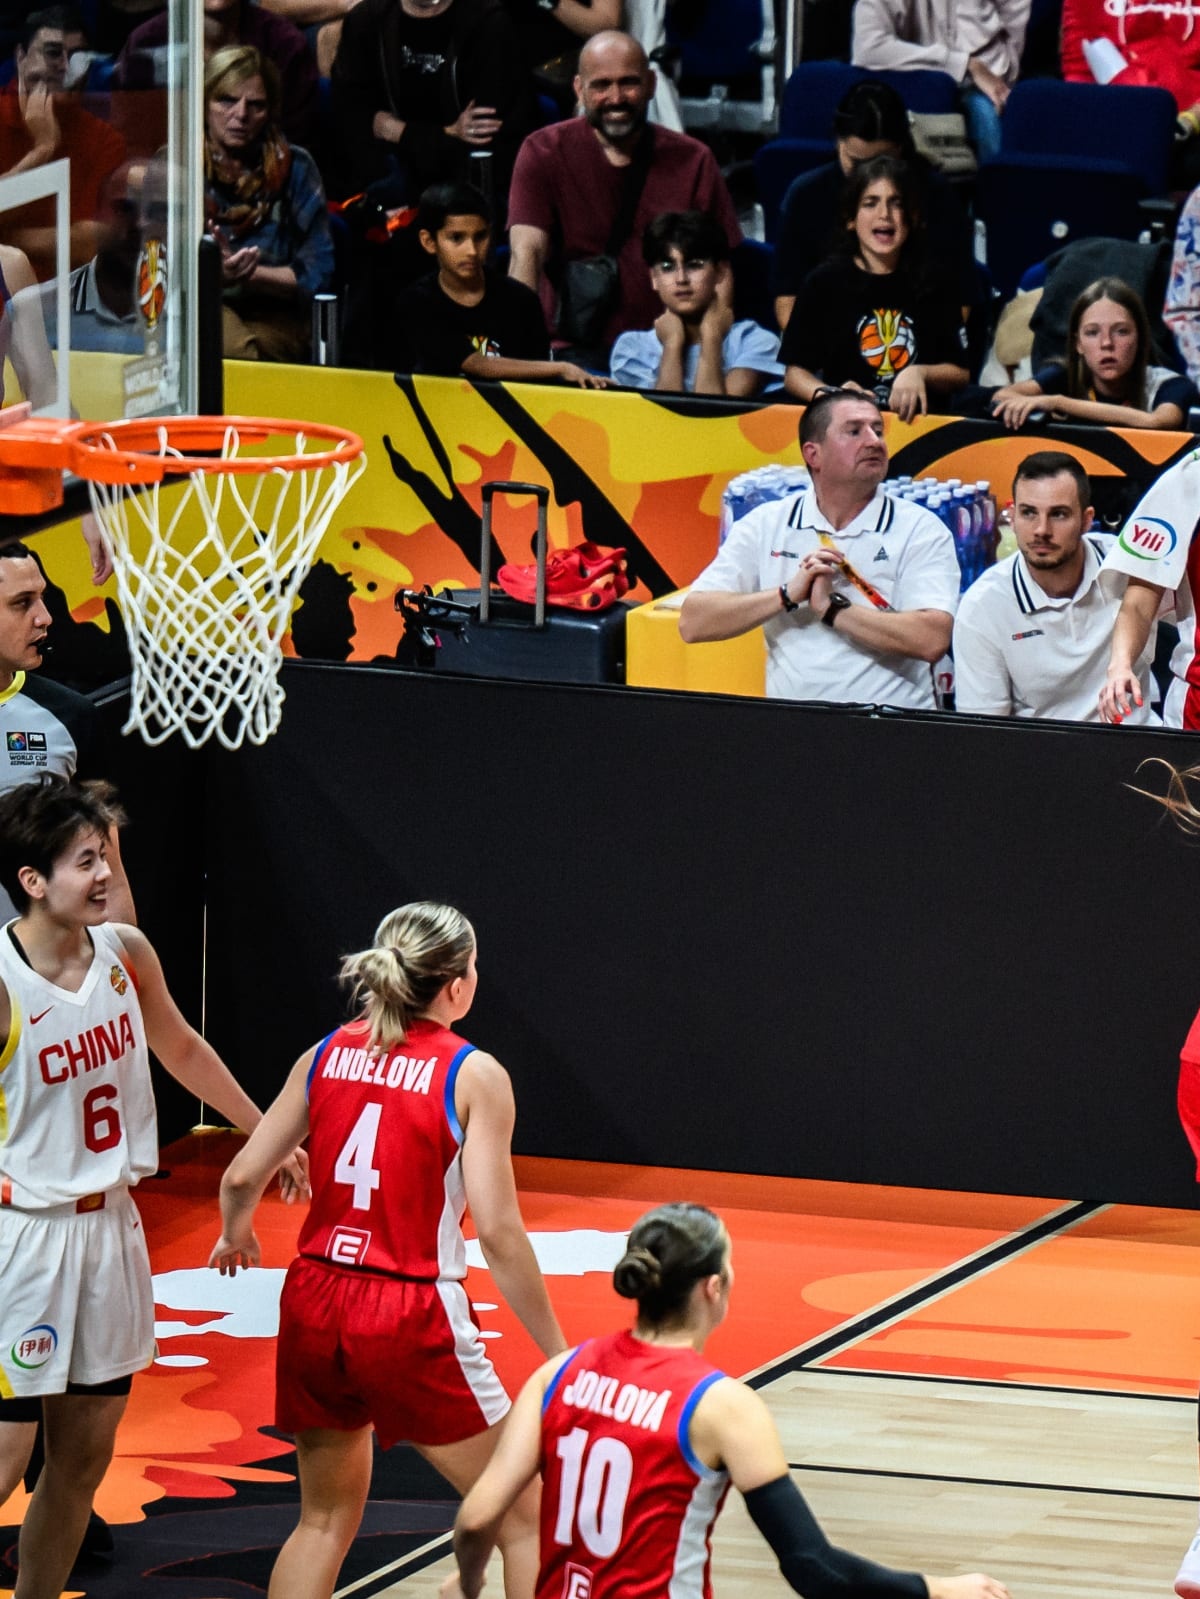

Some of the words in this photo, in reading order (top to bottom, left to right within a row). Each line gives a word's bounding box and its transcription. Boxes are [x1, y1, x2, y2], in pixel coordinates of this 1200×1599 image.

[1132, 524, 1165, 552] Yili
[39, 1012, 136, 1086] CHINA
[83, 1083, 122, 1154] 6
[334, 1102, 383, 1211] 4
[19, 1335, 52, 1357] 伊利
[562, 1368, 672, 1432] JOKLOVÁ
[554, 1426, 634, 1559] 10
